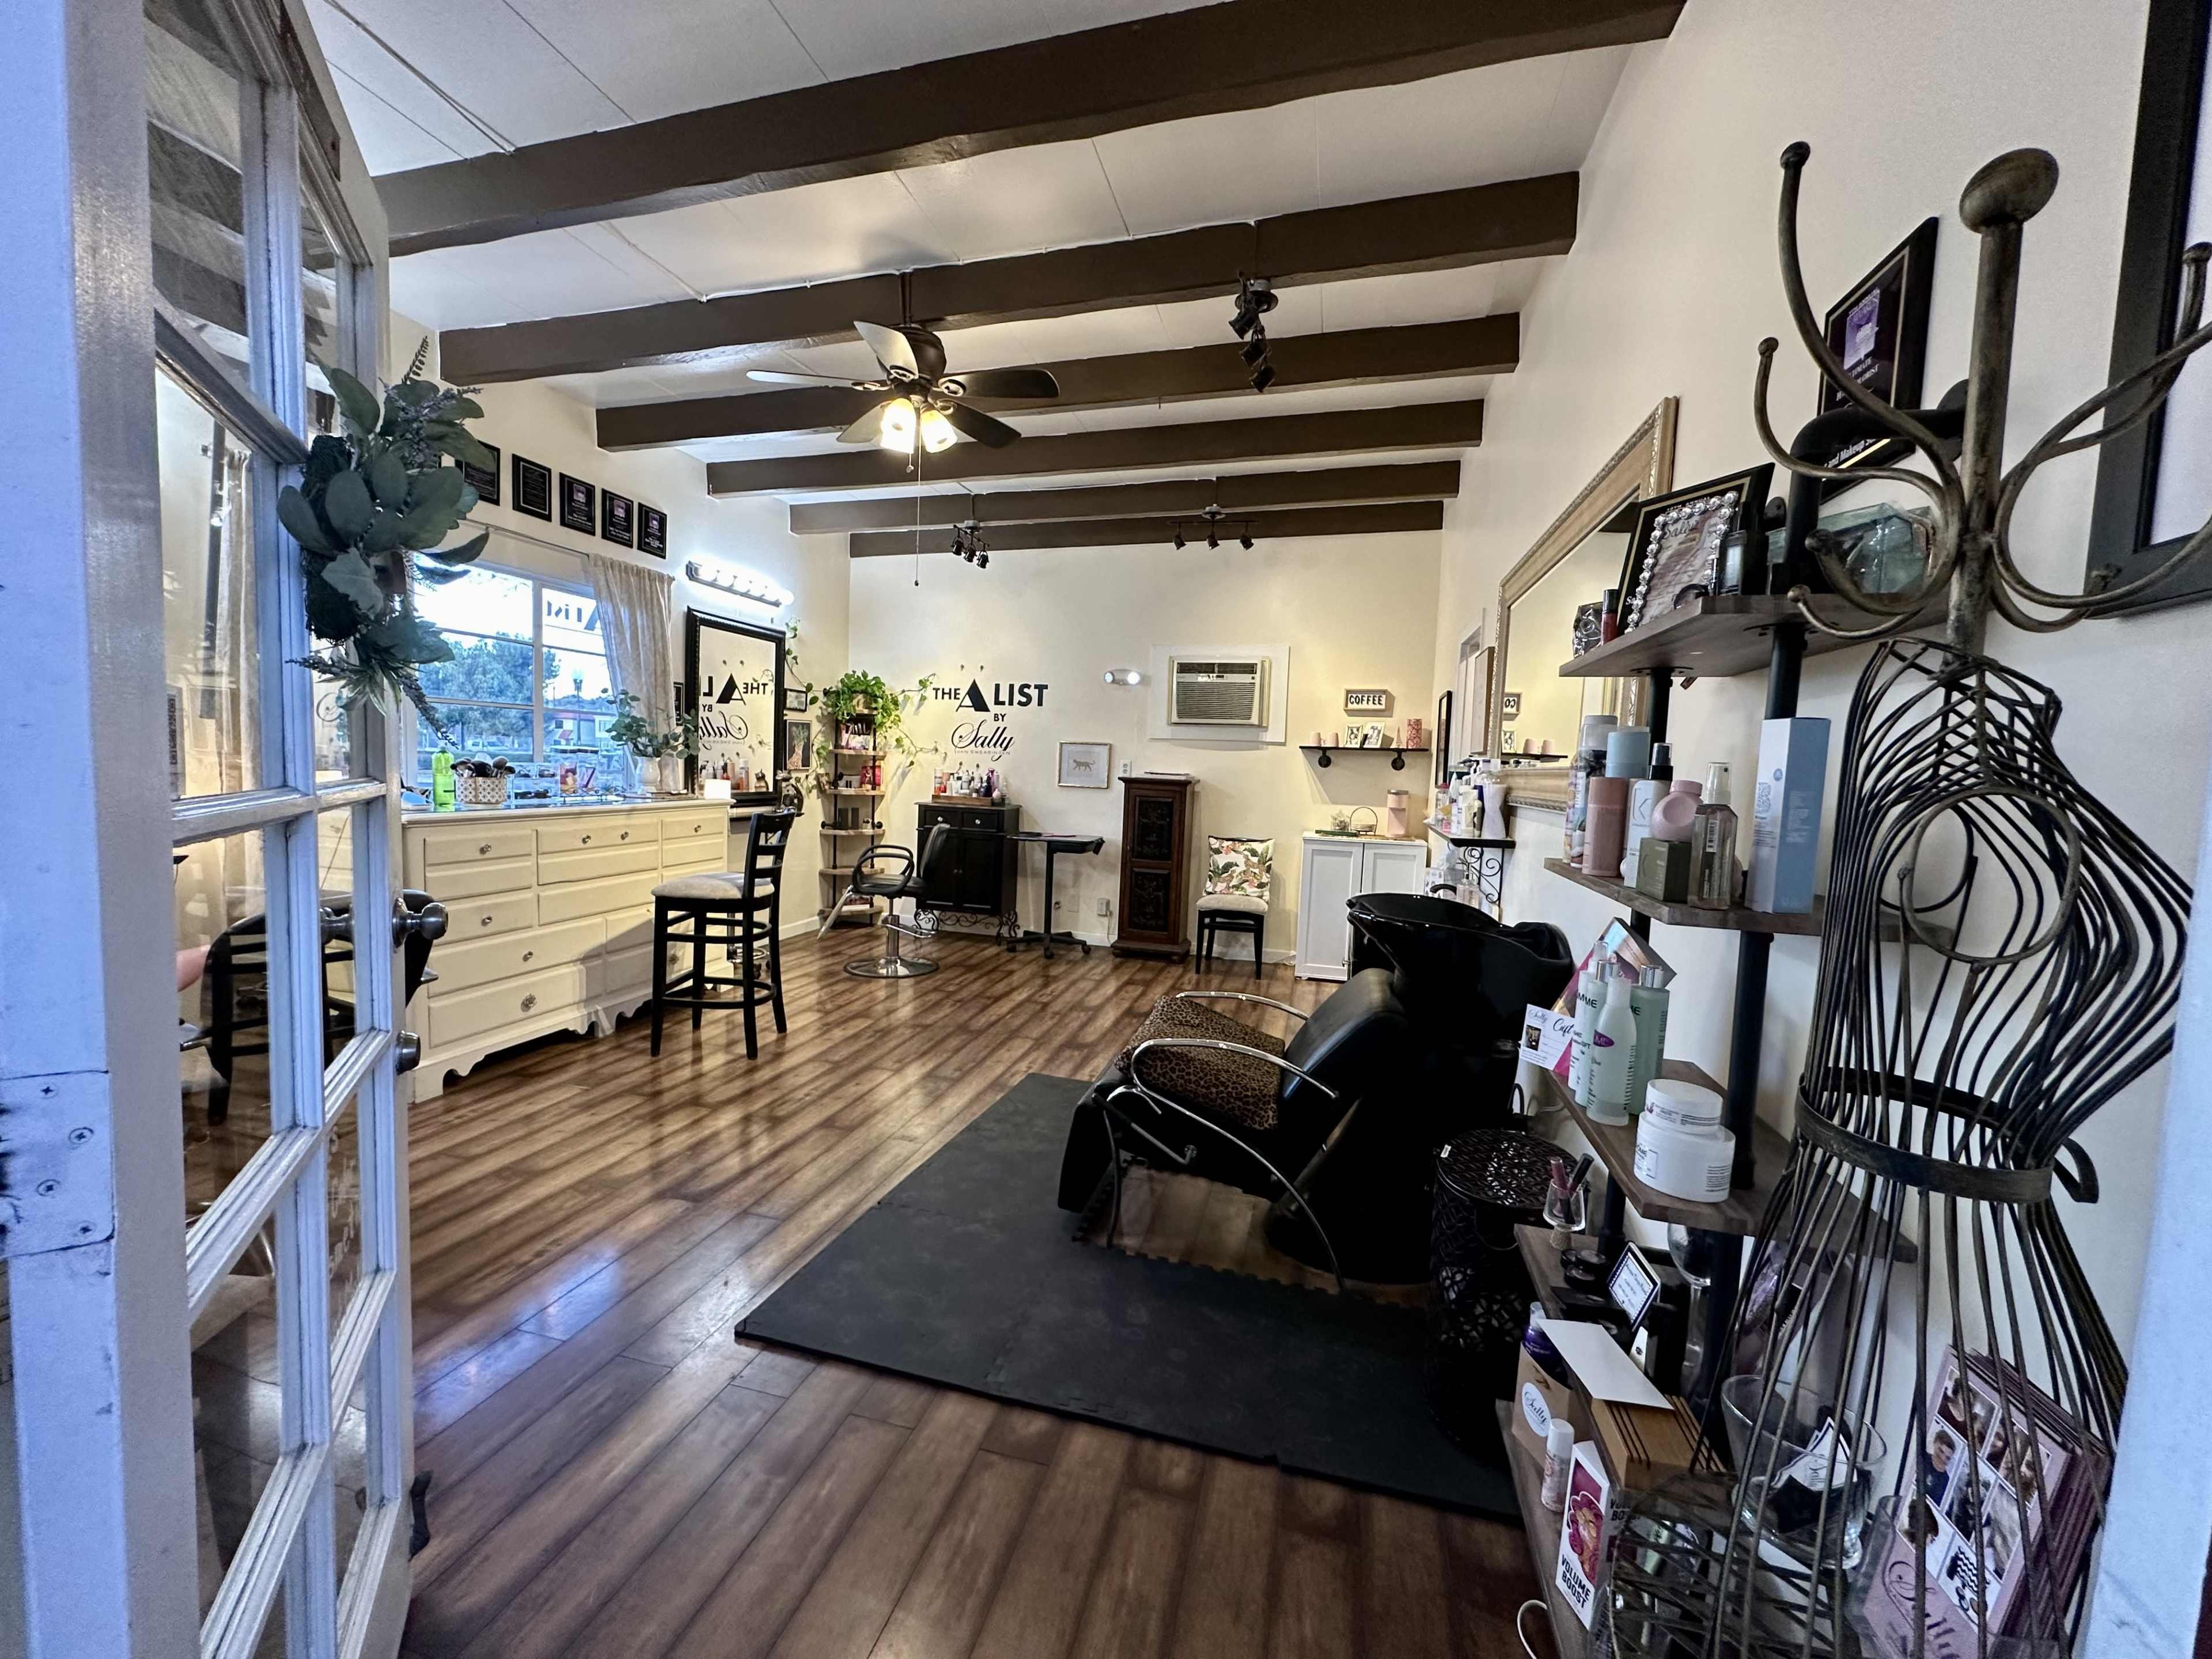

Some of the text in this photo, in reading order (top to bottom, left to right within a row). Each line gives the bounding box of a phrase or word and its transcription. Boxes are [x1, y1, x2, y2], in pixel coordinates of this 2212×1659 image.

[933, 679, 1048, 712] THE A LIST
[1349, 695, 1383, 705] COFFEE
[994, 713, 1006, 722] BY
[952, 719, 1014, 762] Sally
[1524, 1391, 1548, 1425] Sally
[1562, 1554, 1591, 1601] VOLUME
[1562, 1570, 1588, 1609] BOOST
